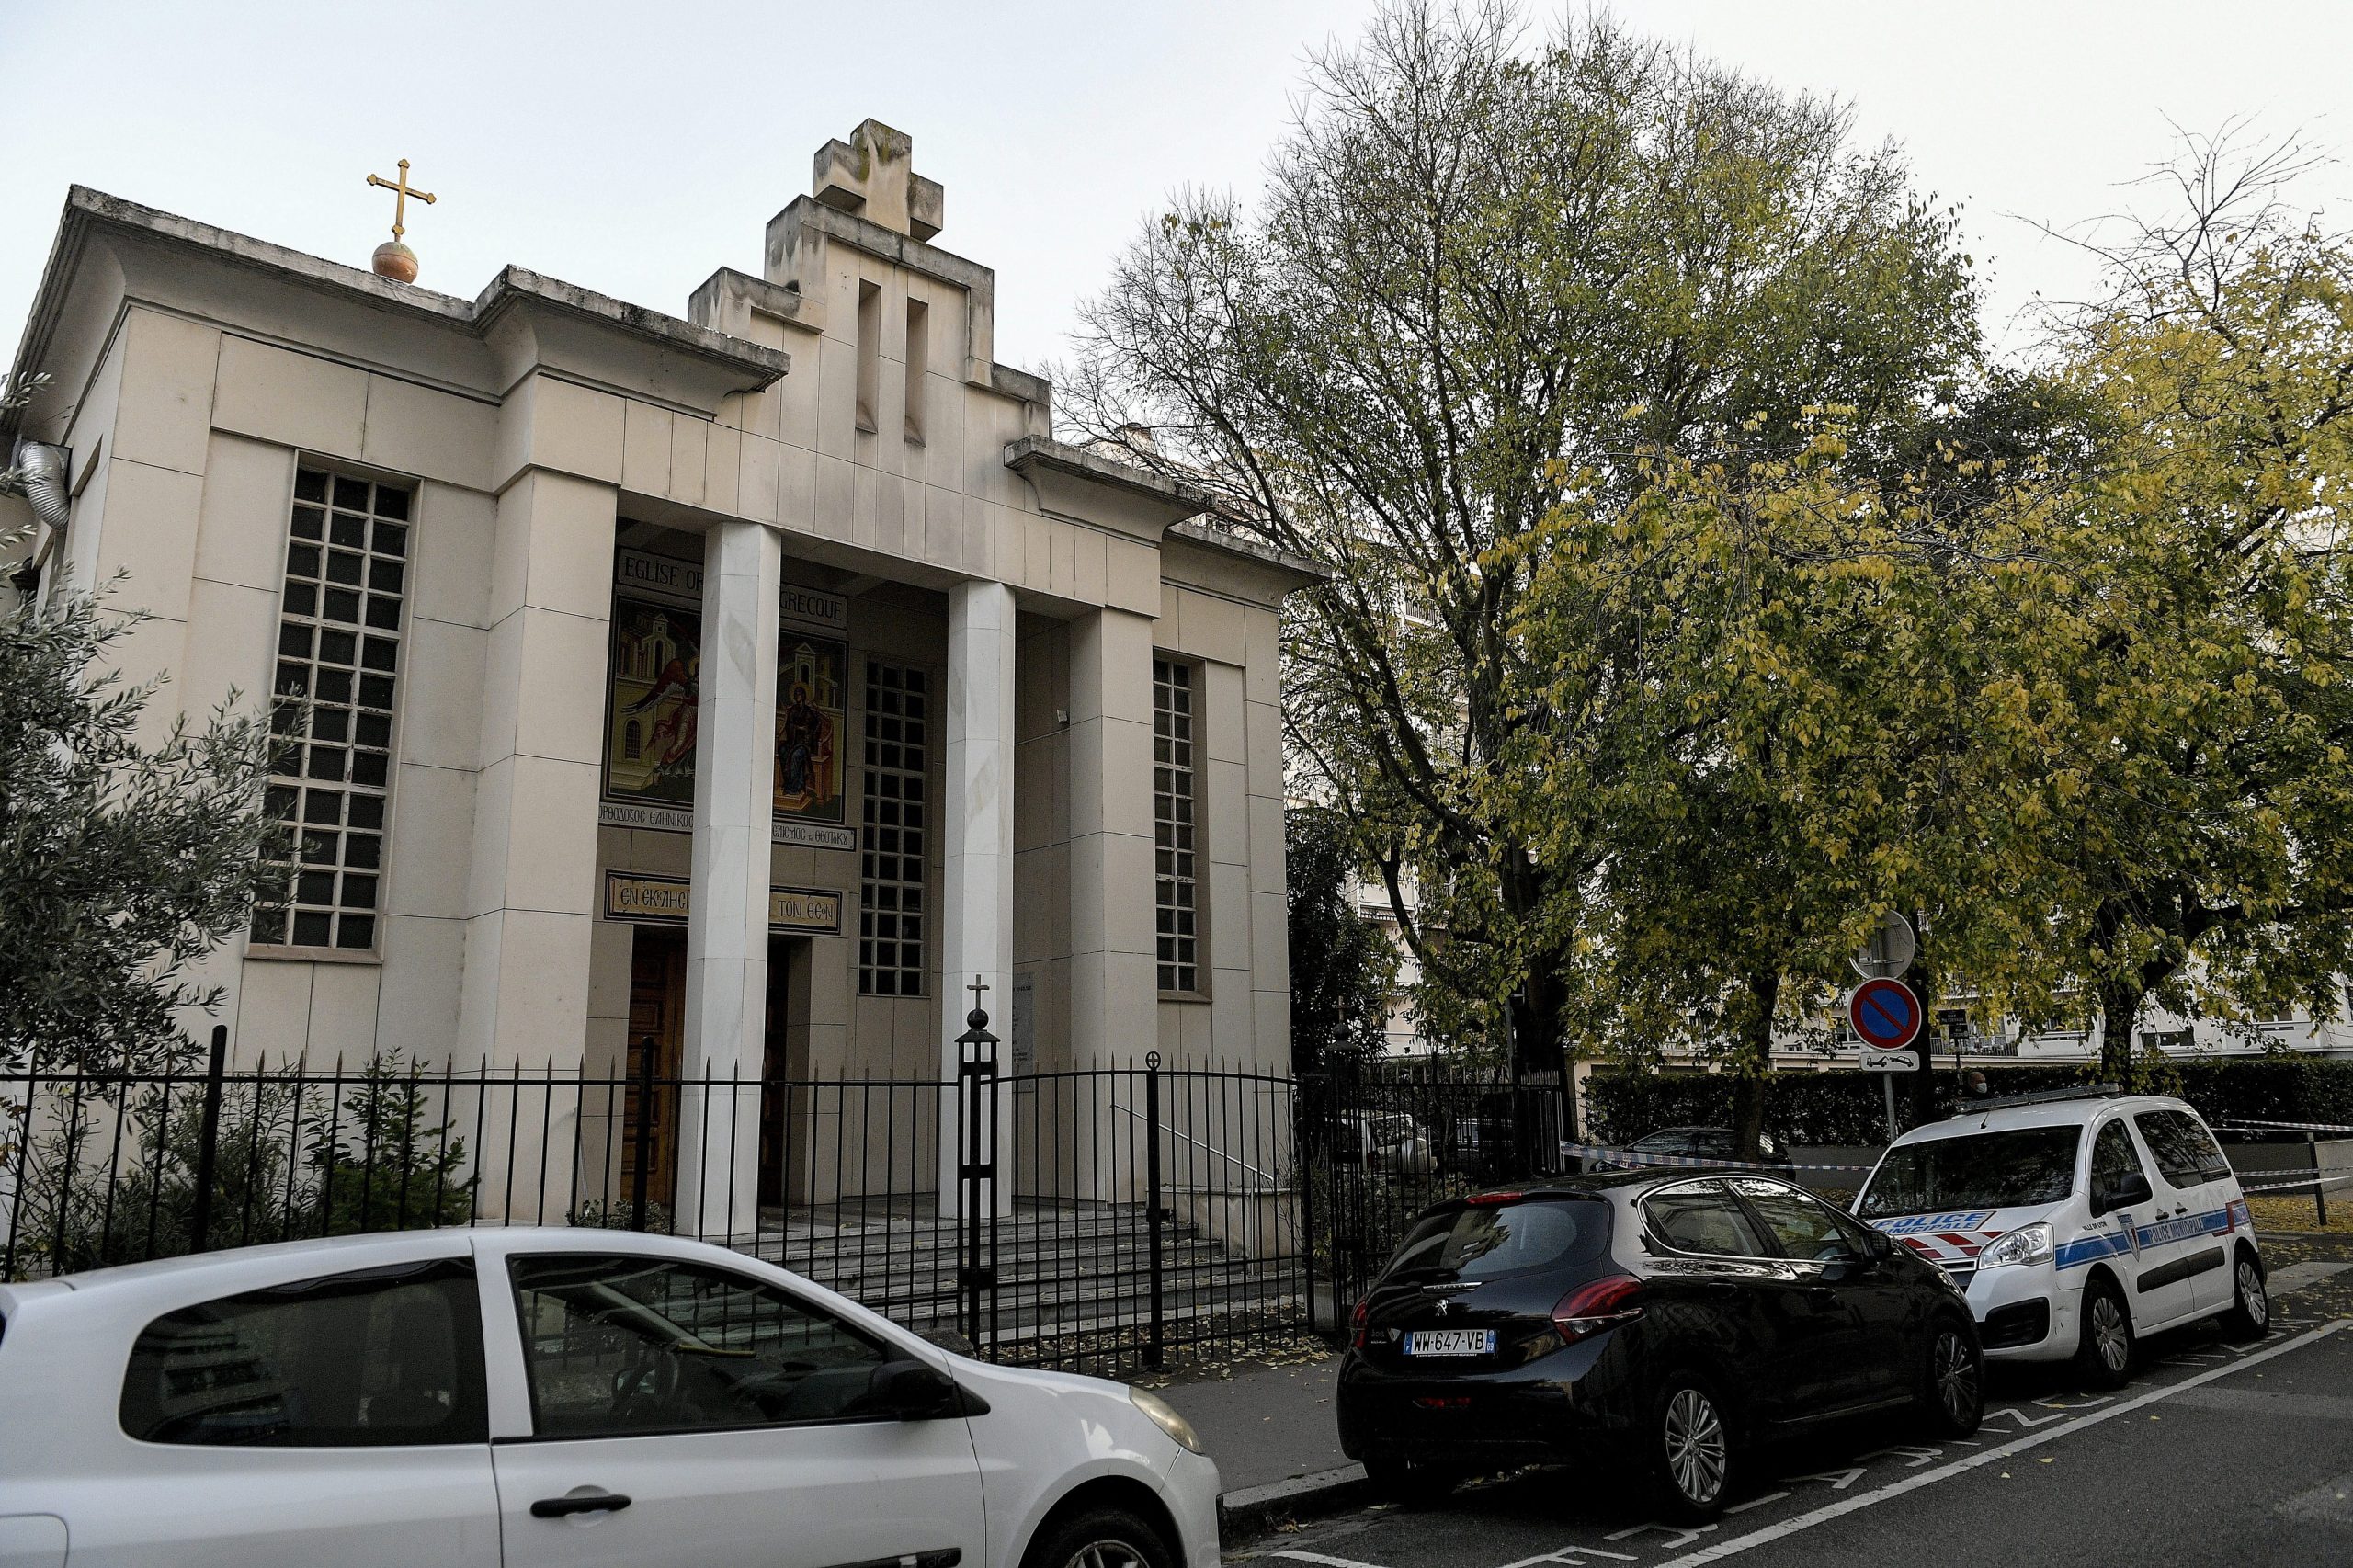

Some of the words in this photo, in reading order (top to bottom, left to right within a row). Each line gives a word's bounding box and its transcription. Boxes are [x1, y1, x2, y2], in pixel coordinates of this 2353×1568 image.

[625, 556, 679, 586] EGLISE
[1874, 1212, 1986, 1228] POLICE
[2147, 1224, 2170, 1243] POLICE
[2170, 1217, 2204, 1238] MUNICIPALE
[1414, 1331, 1483, 1351] WW-647-VB
[1487, 1342, 1494, 1351] 69
